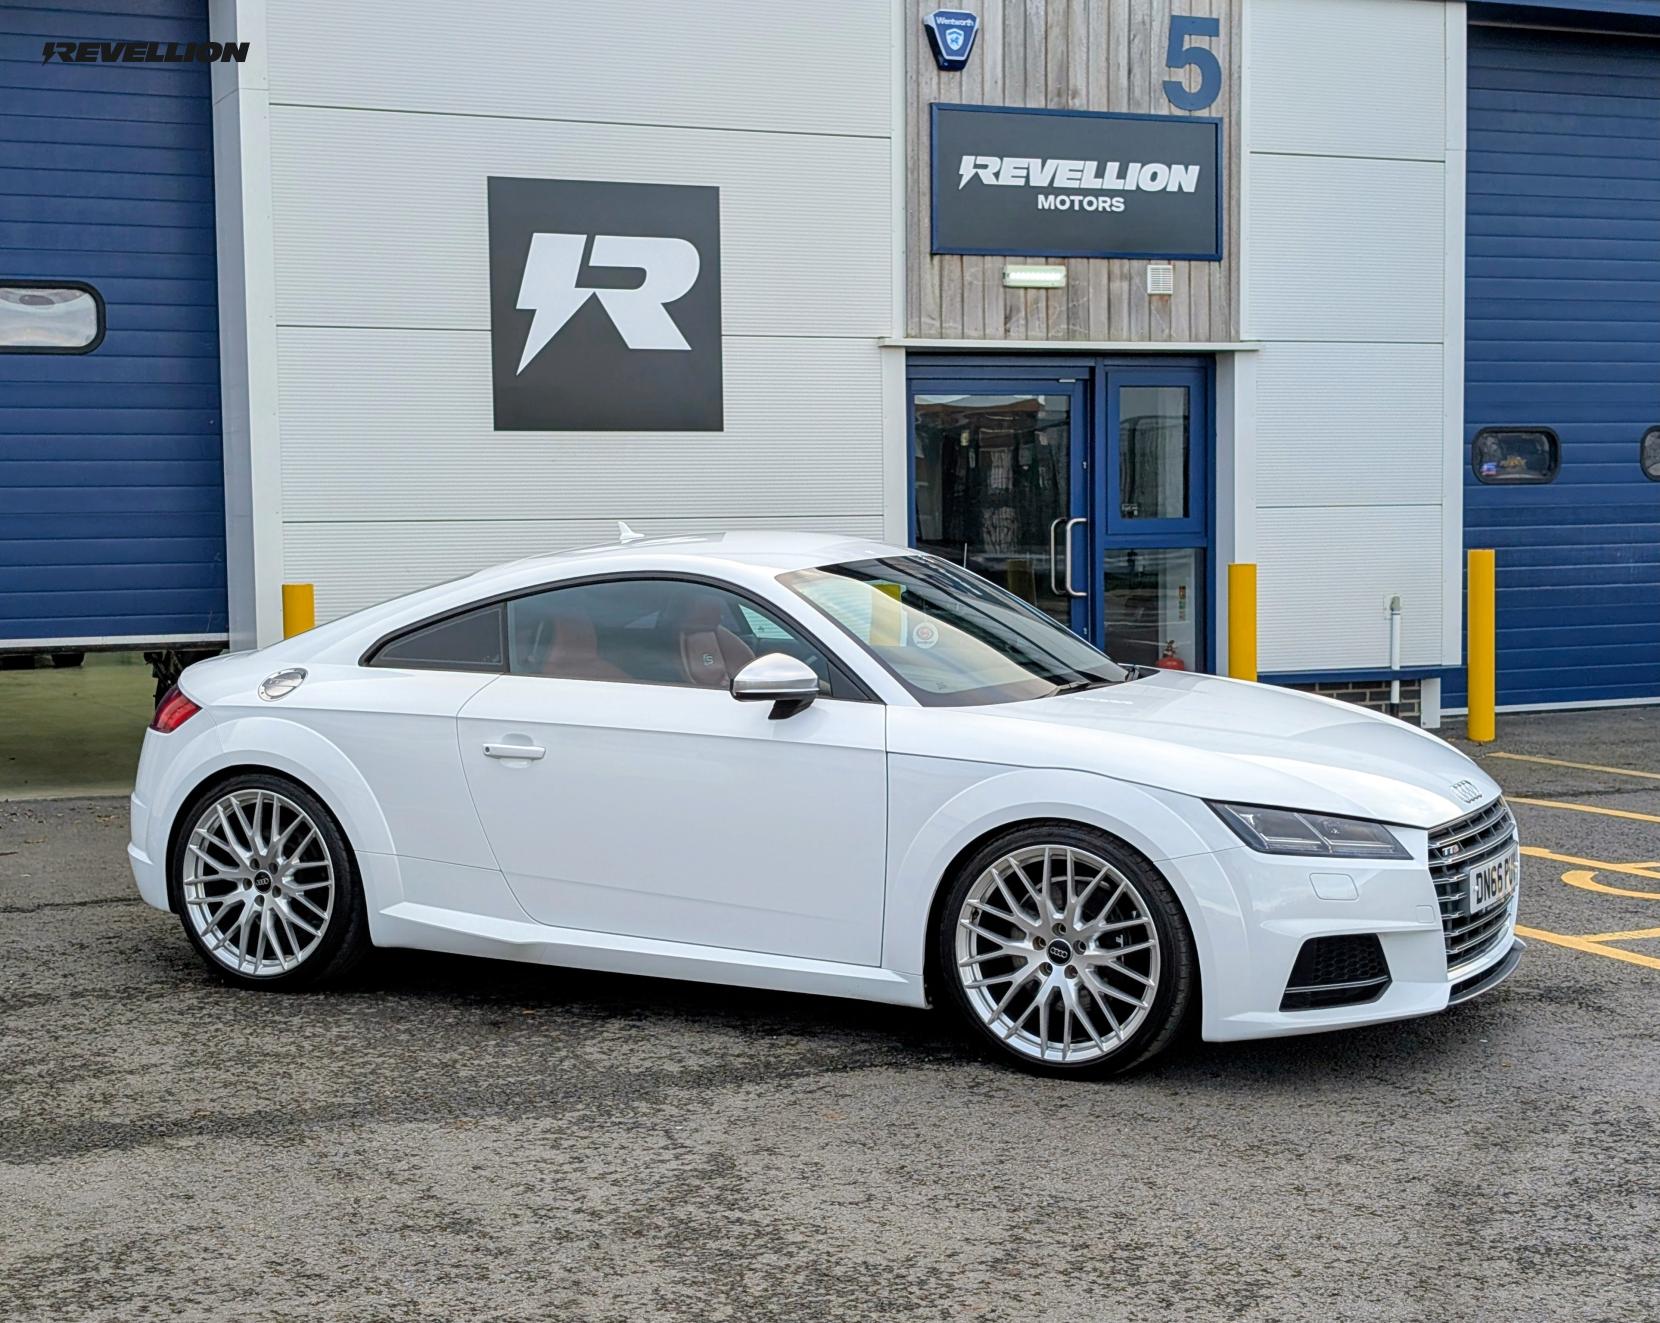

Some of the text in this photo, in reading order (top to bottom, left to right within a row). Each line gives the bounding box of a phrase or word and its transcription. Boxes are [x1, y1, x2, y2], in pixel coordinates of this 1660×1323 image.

[1163, 15, 1222, 111] 5
[958, 155, 1201, 193] REVELLION
[1037, 194, 1126, 212] MOTORS
[1475, 862, 1503, 905] DN66
